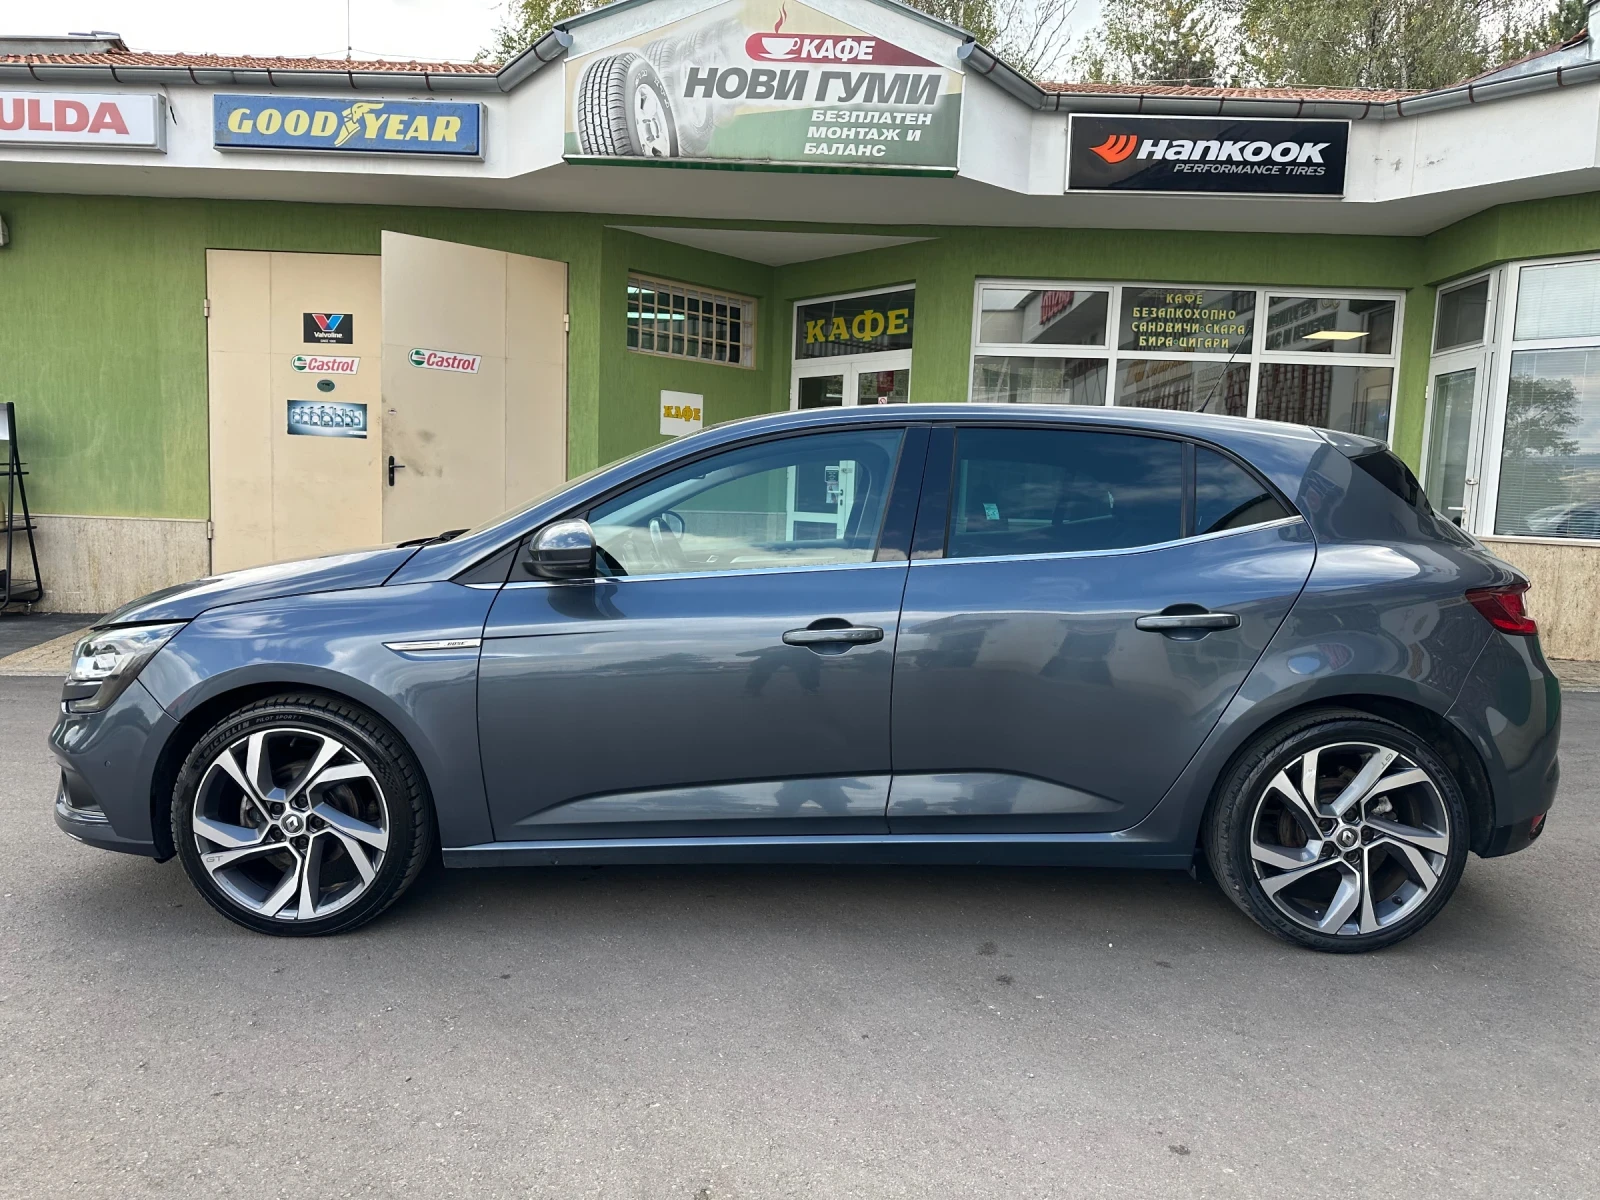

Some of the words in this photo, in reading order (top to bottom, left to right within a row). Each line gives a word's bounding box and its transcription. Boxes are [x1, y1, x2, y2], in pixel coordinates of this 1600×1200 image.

[800, 38, 876, 61] КАФЕ
[683, 66, 810, 101] НОВИ
[814, 70, 942, 106] ГУМИ
[811, 109, 933, 125] БЕЗПЛАТЕН
[806, 126, 902, 141] МОНТАЖ
[906, 129, 922, 142] И
[803, 142, 887, 157] БАЛАНС
[1173, 163, 1280, 175] PERFORMANCE
[1284, 165, 1327, 176] TIRES
[1166, 293, 1203, 305] КАФЕ
[806, 308, 909, 344] КАФЕ
[1204, 323, 1245, 335] СКАРА
[313, 331, 343, 339] Valvoline
[1139, 336, 1173, 347] БИРА
[1178, 337, 1229, 349] ЦИГАРИ
[307, 357, 355, 372] Castrol
[426, 352, 477, 371] Castrol
[663, 405, 701, 422] КАФЕ
[203, 720, 250, 757] MICHELIN
[1380, 752, 1394, 769] GT
